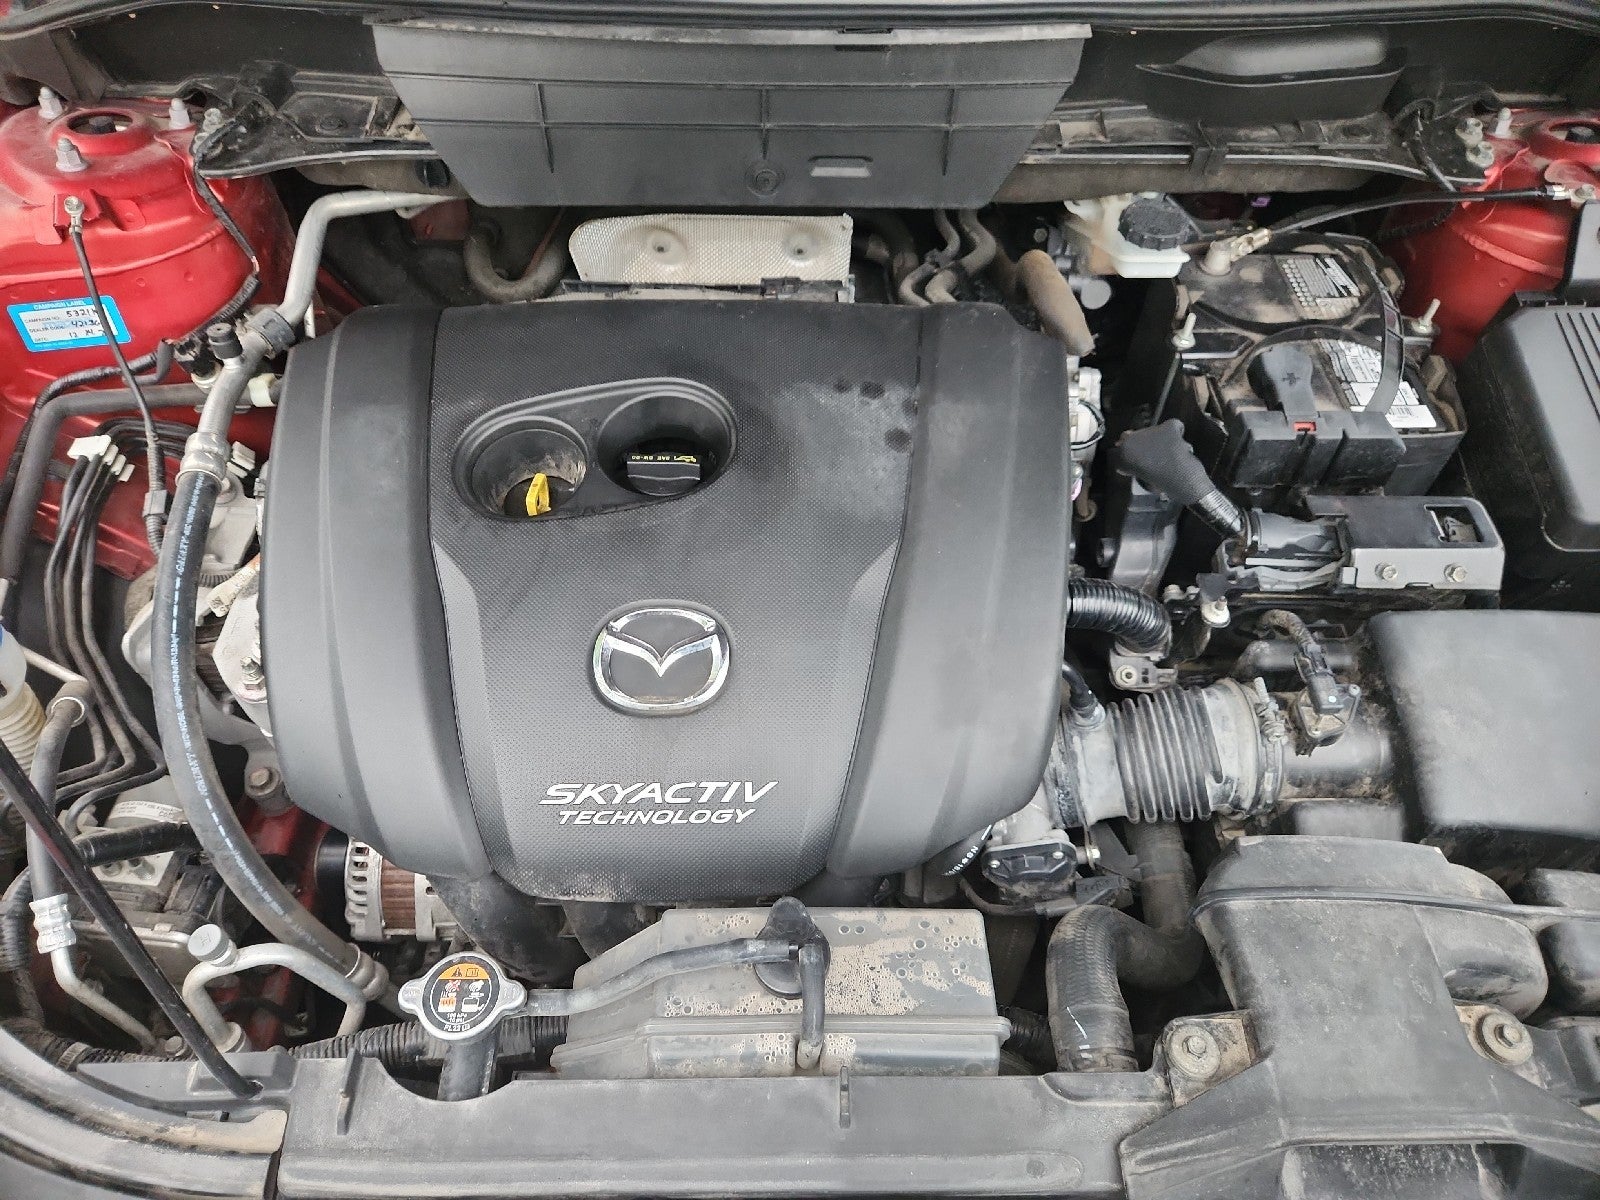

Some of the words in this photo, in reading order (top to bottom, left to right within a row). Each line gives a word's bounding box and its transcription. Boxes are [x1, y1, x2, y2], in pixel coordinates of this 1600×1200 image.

[33, 302, 66, 310] CAMPAIGN
[538, 781, 779, 805] SKYACTIV
[559, 808, 756, 825] TECHNOLOGY
